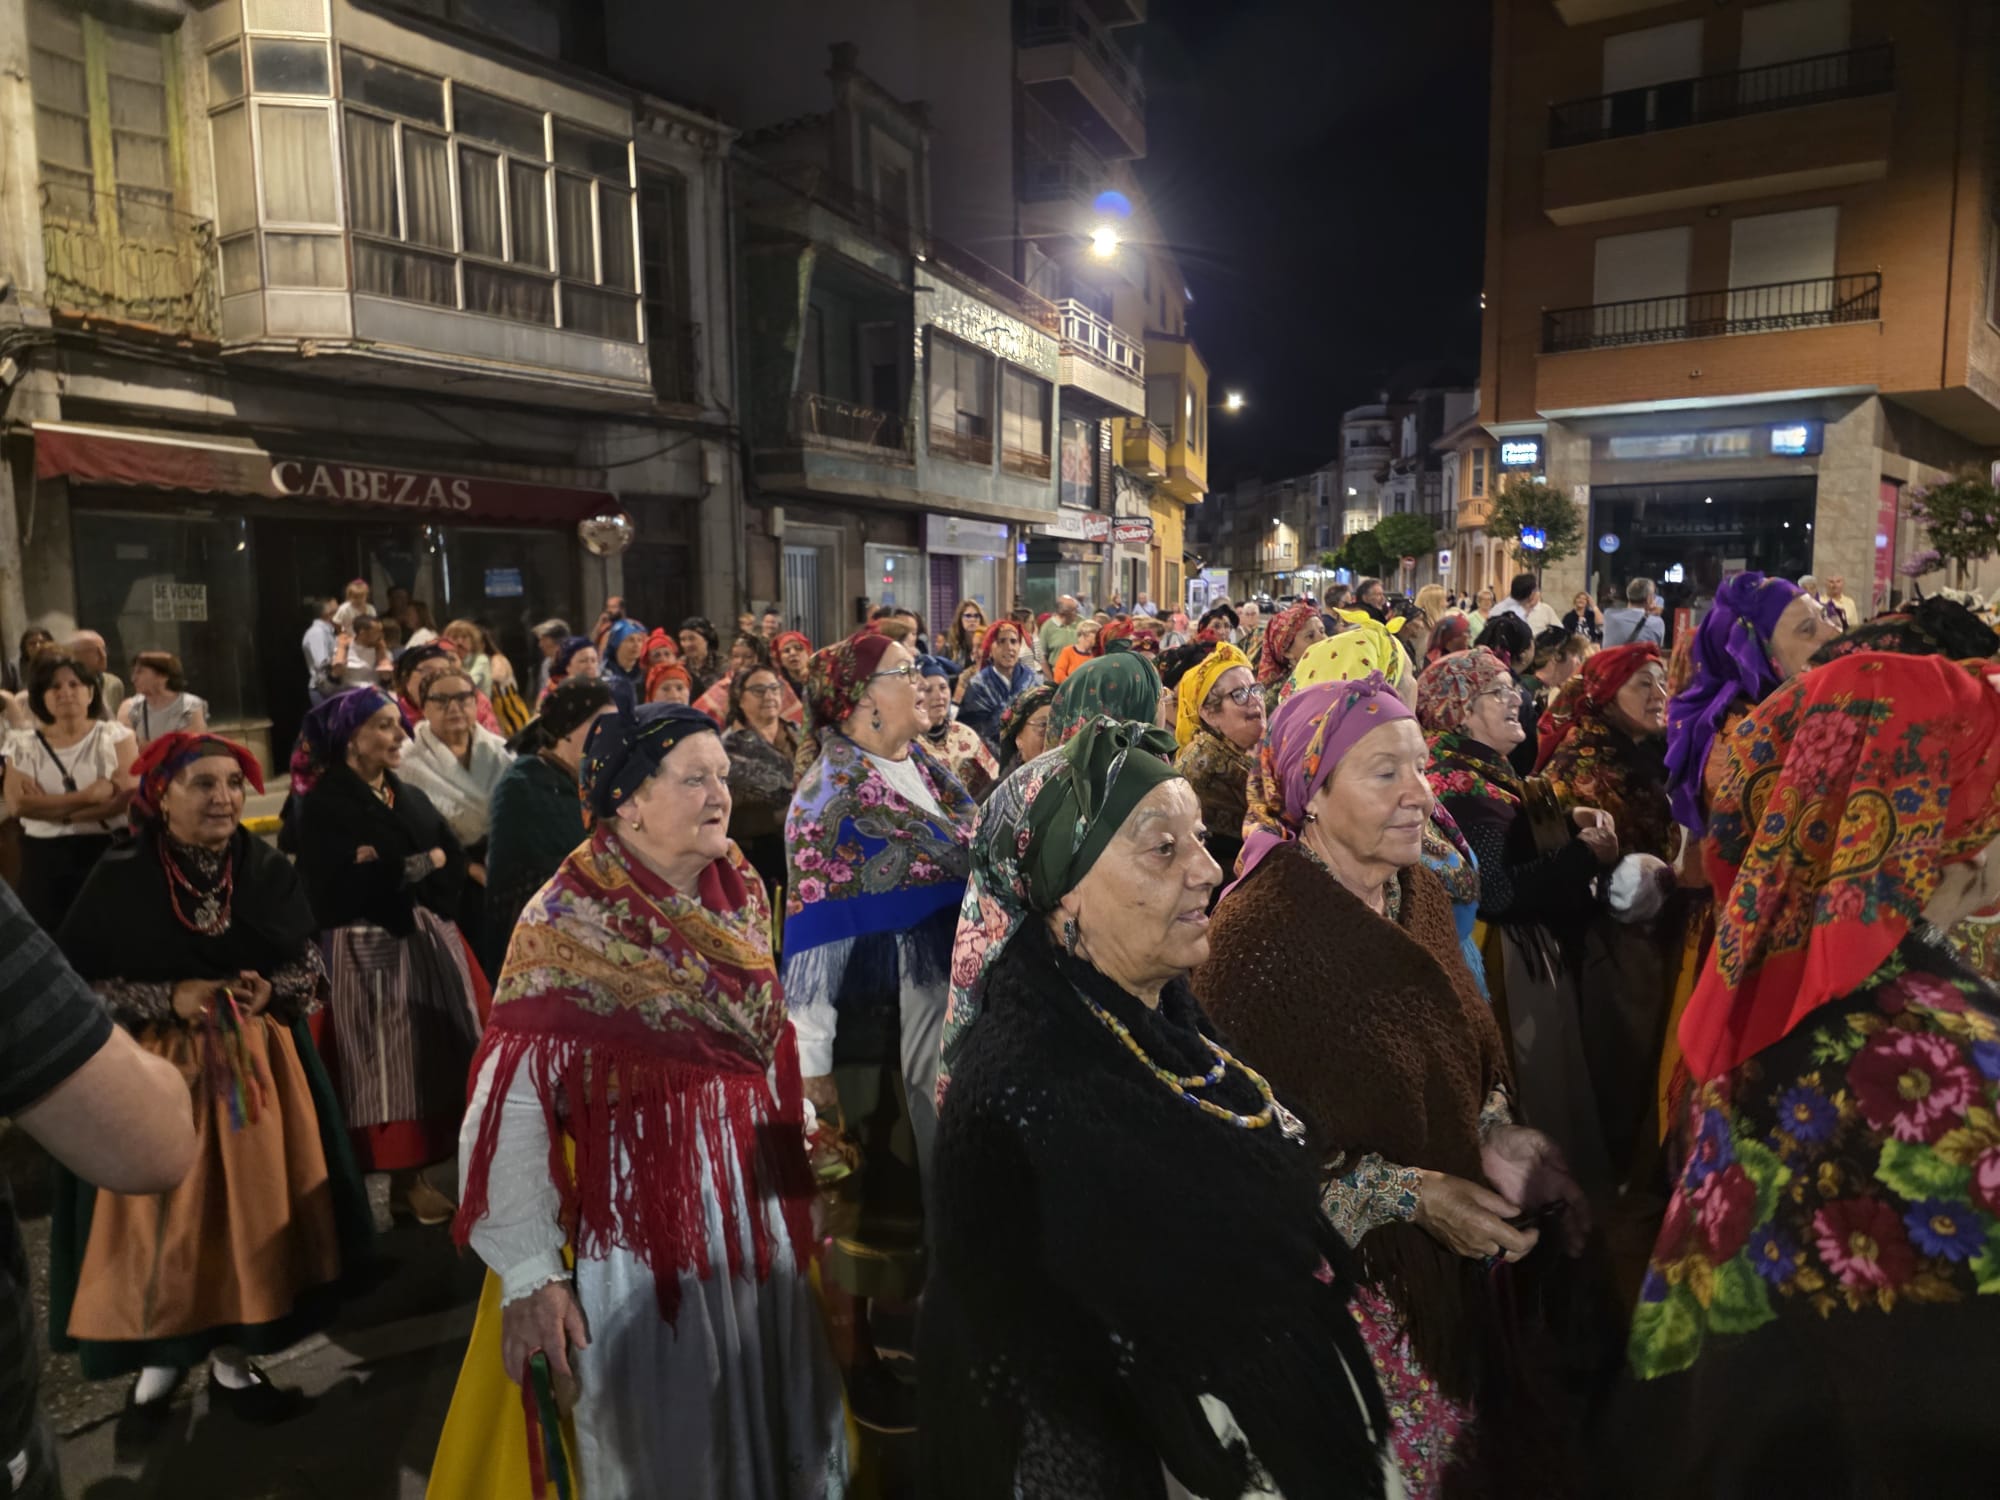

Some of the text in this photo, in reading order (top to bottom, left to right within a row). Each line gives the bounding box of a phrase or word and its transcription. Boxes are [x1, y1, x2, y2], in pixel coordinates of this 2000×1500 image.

[271, 461, 472, 511] CABEZAS
[1115, 528, 1150, 541] Rodera
[155, 584, 205, 601] SE VENDE
